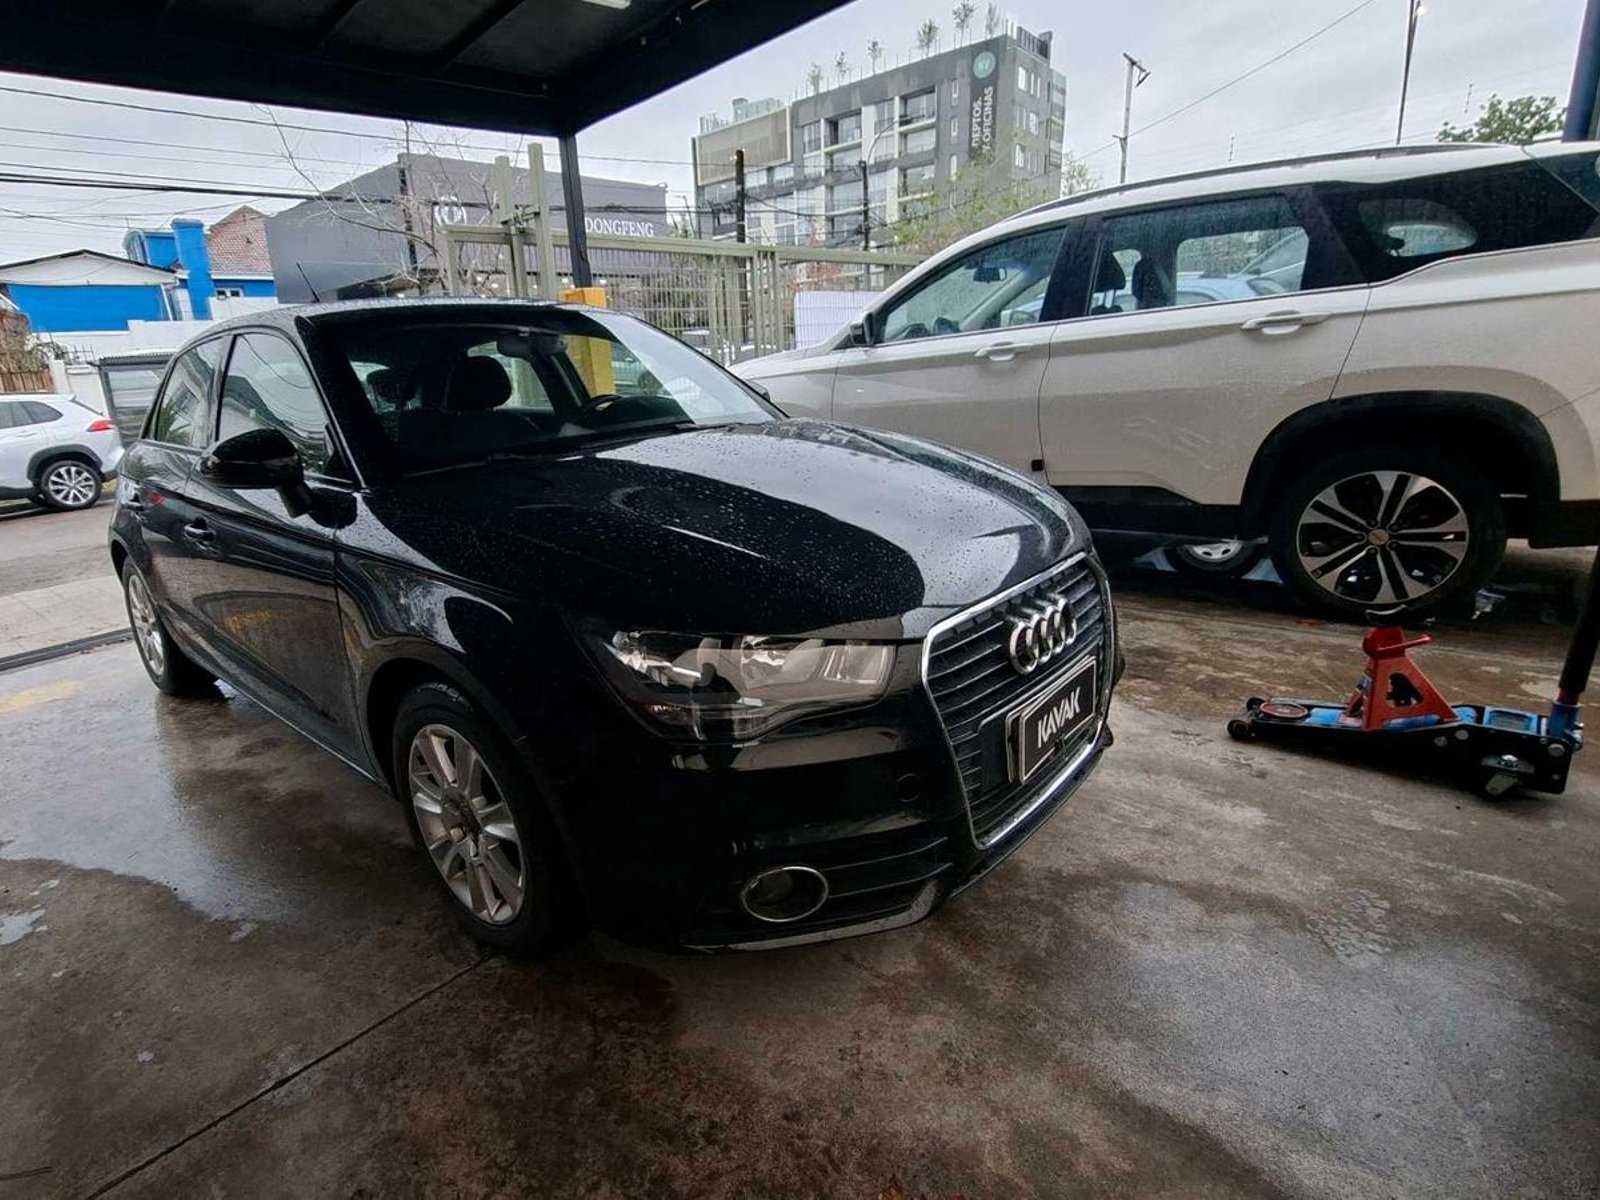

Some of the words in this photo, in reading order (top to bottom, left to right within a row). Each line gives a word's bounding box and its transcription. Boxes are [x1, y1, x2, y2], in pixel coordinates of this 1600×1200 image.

[982, 86, 993, 142] OFICINAS
[584, 216, 654, 238] DONGFENG
[1038, 687, 1080, 748] KAVAK
